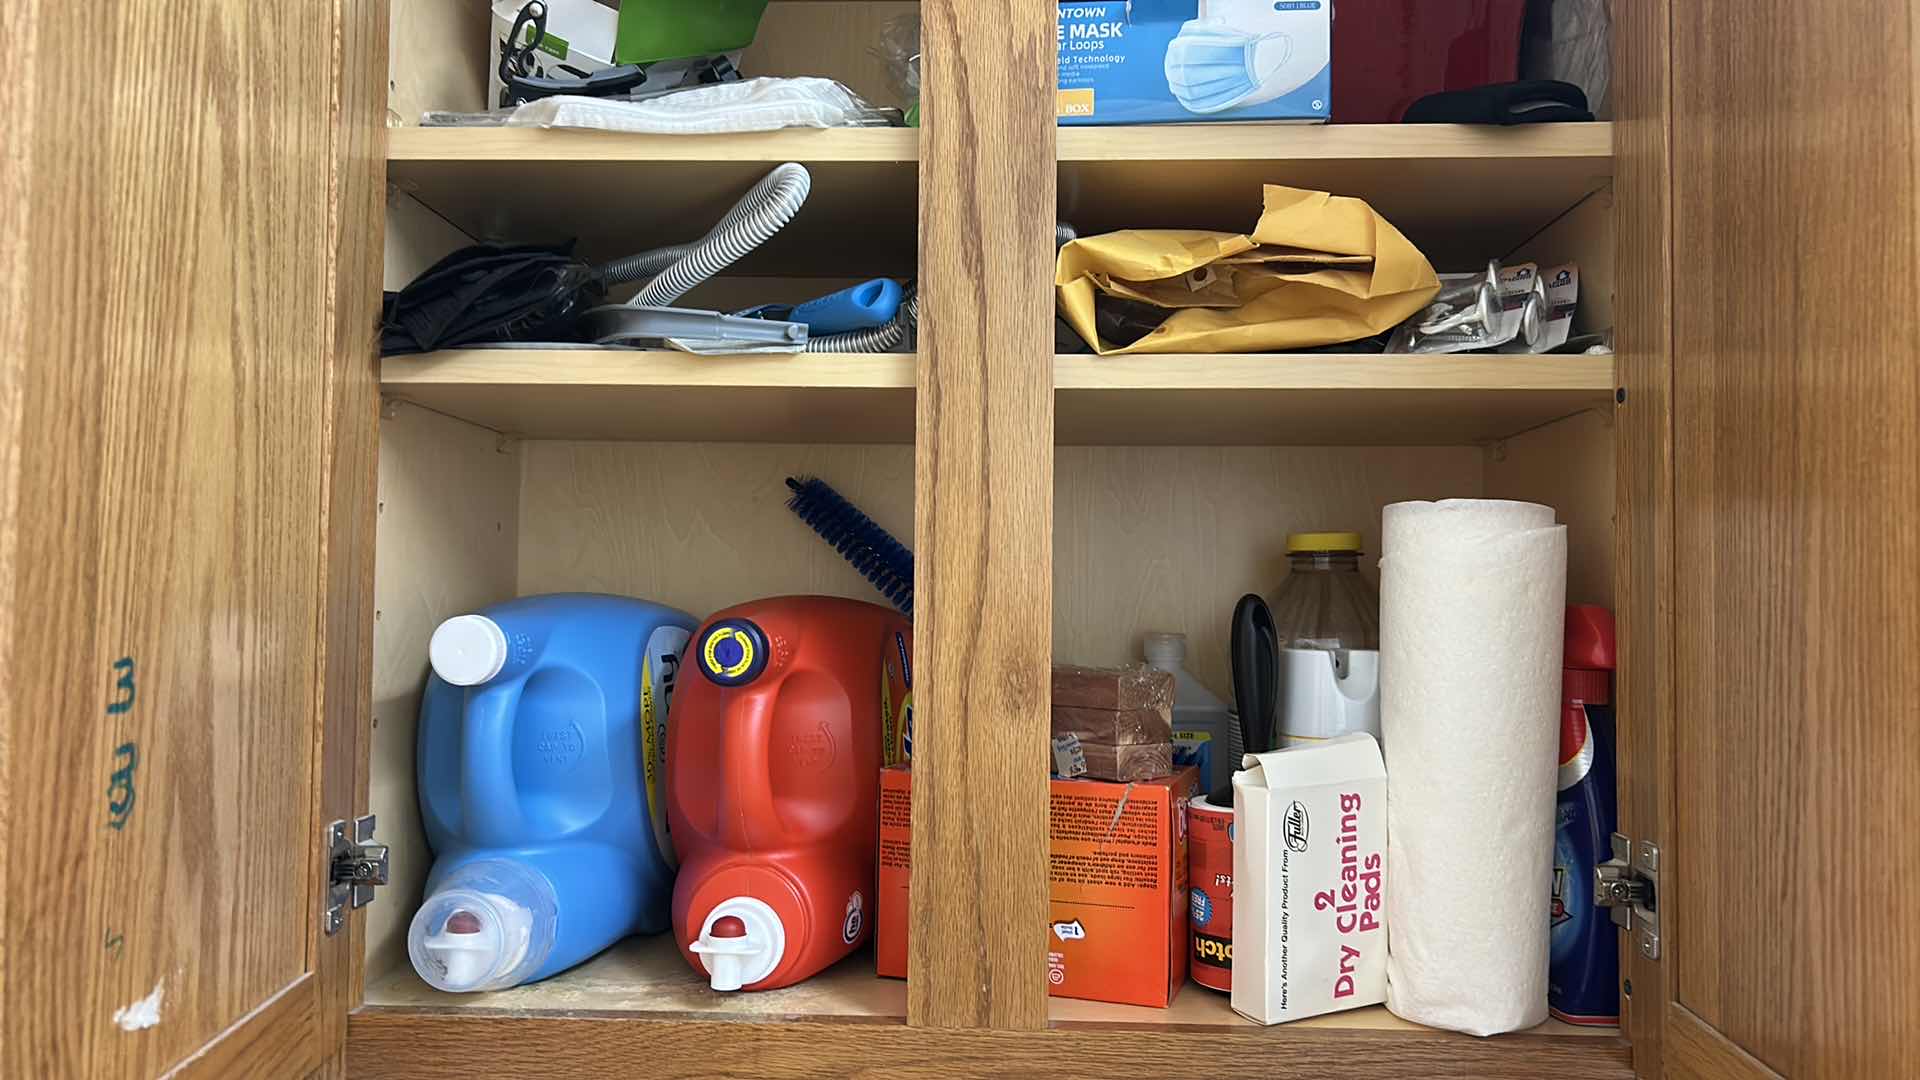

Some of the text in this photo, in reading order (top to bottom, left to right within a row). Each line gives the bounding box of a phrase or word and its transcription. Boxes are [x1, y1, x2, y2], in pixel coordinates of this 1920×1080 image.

[1070, 22, 1123, 39] MASK
[1070, 40, 1105, 52] Loops
[1073, 54, 1126, 65] Technology
[1286, 801, 1308, 852] Fuller
[1314, 889, 1335, 911] 2
[1334, 792, 1361, 999] Dry Cleaning
[1359, 853, 1381, 932] Pads
[1280, 849, 1290, 1010] Here's Another Quality Product From
